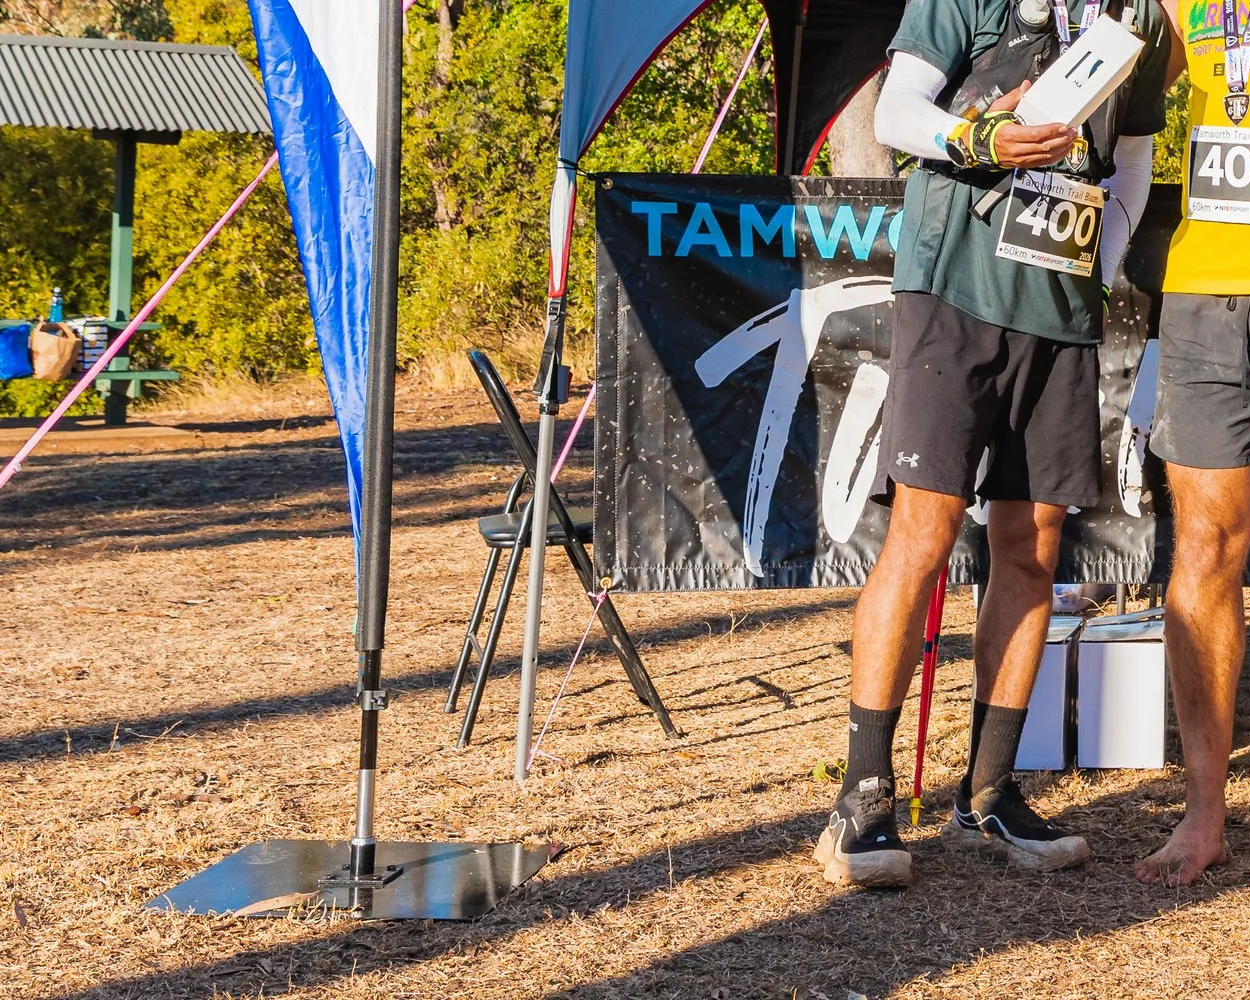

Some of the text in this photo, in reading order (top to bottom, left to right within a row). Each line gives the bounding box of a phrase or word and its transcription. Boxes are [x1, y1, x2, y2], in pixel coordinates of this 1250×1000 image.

[1195, 128, 1231, 139] Tamworth
[1021, 177, 1065, 195] Tamworth
[1067, 188, 1084, 199] Trail
[1192, 202, 1211, 212] 60km
[1016, 195, 1096, 247] 400
[631, 201, 904, 261] TAMW
[1003, 245, 1028, 259] 60km
[1078, 251, 1092, 262] 2026
